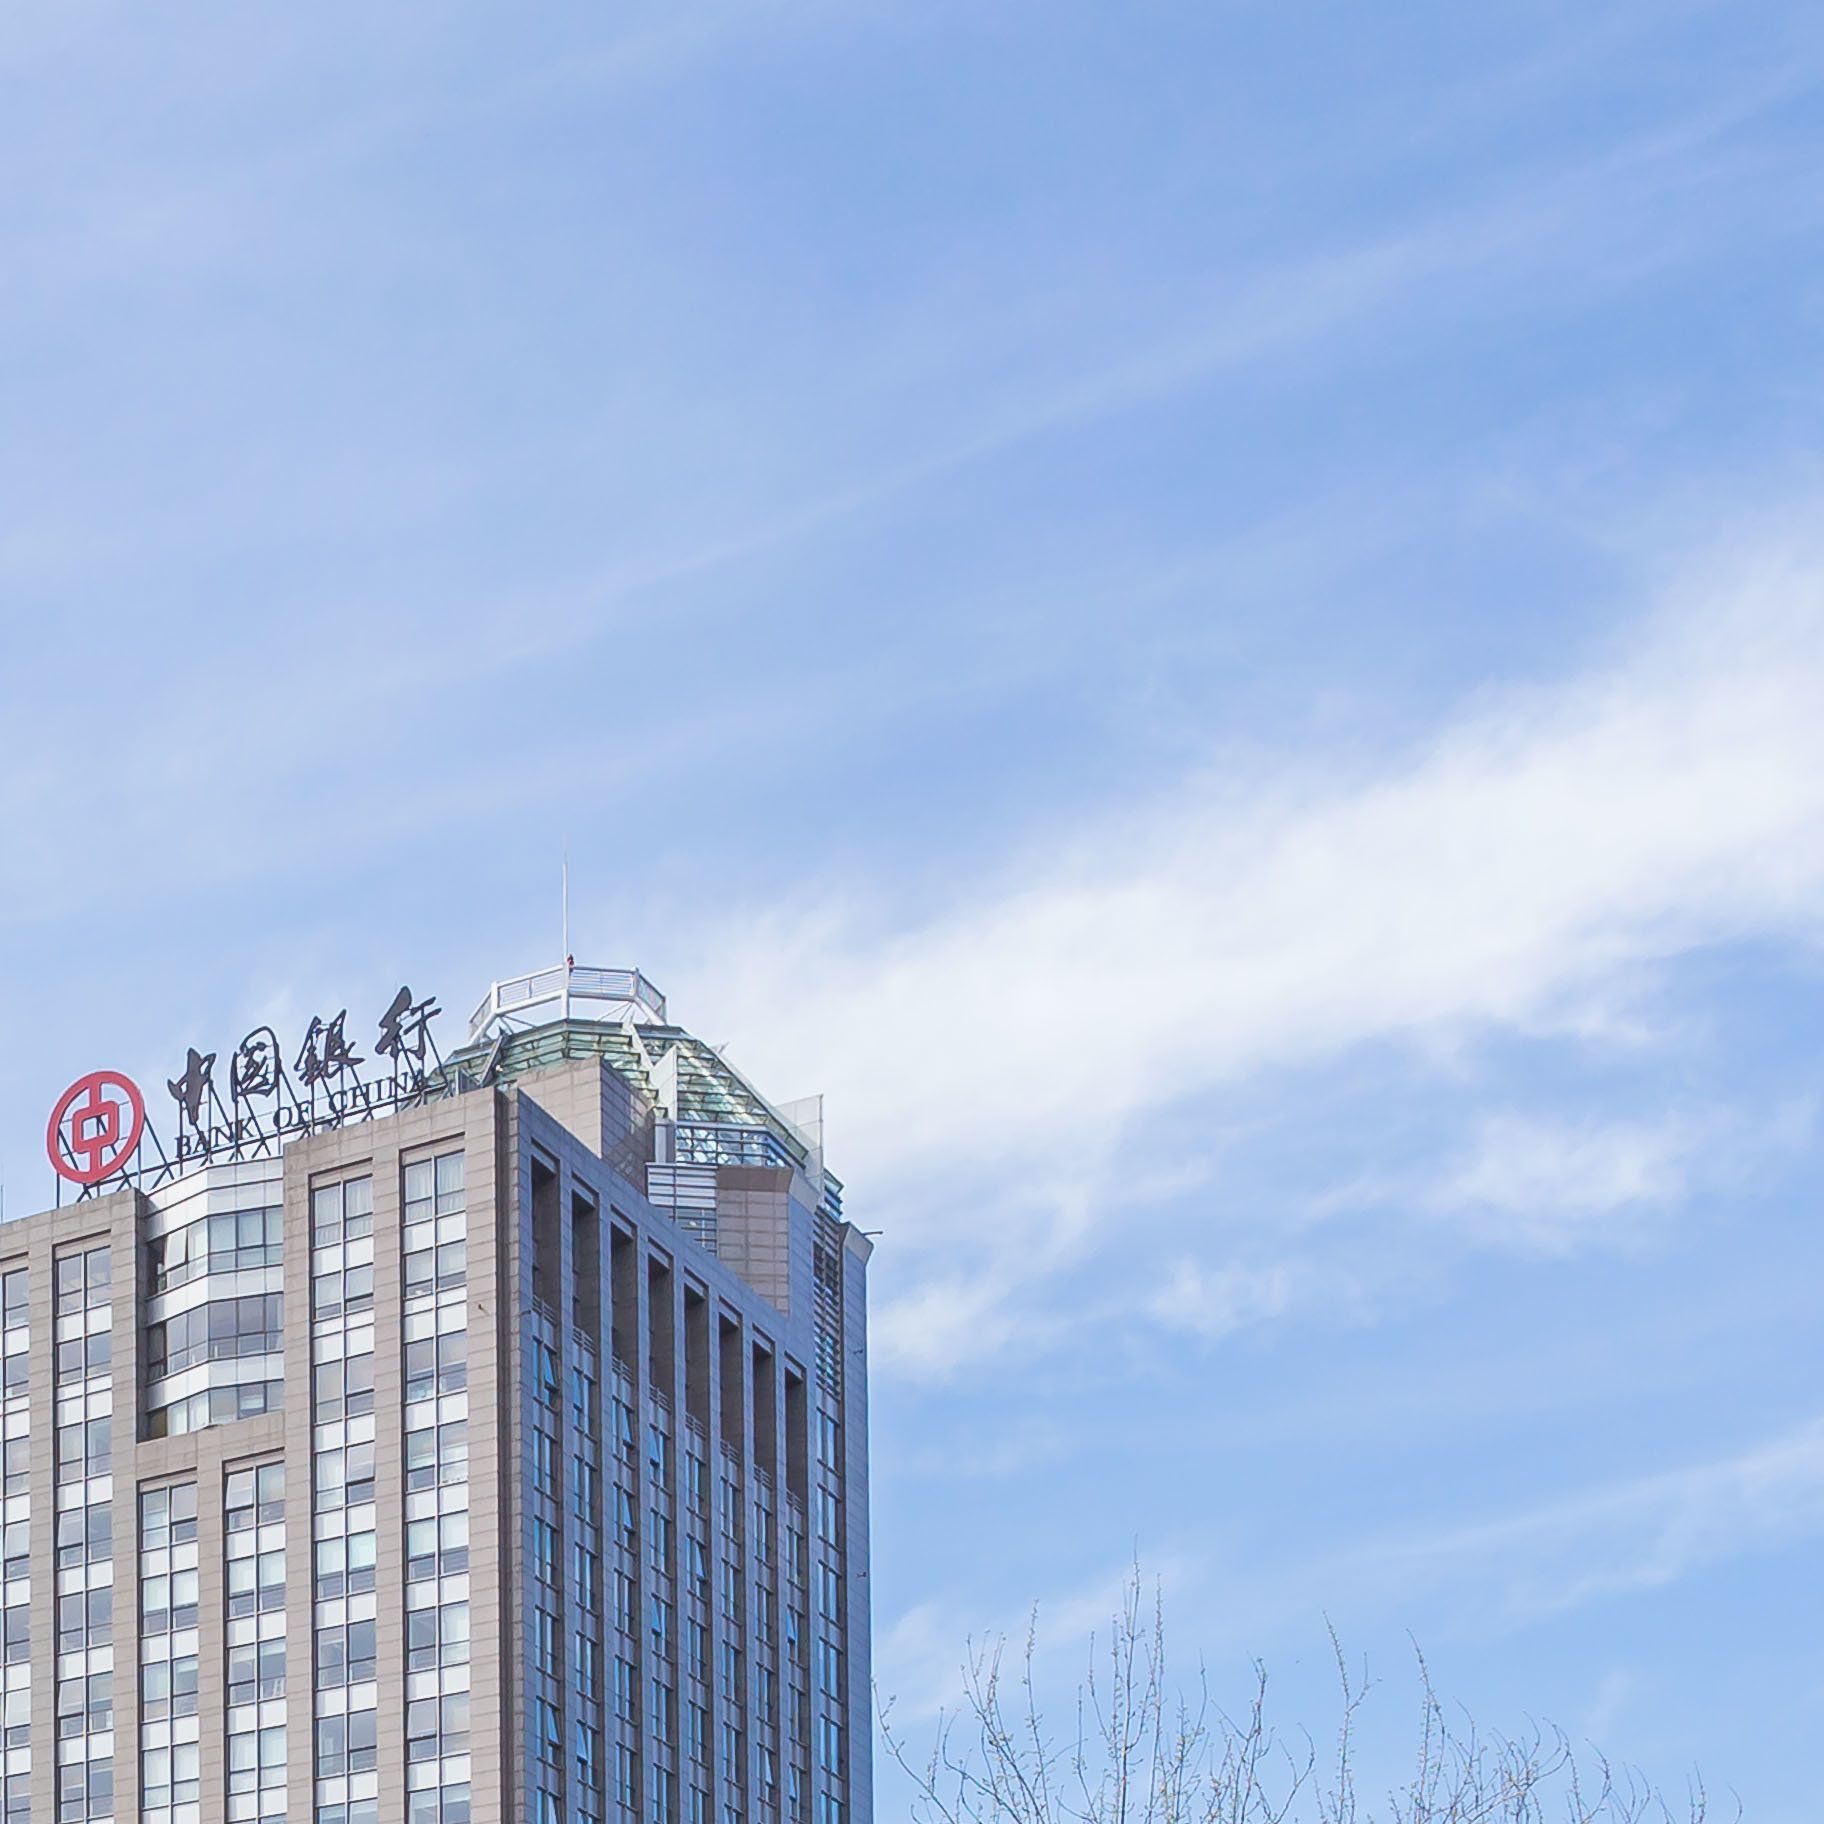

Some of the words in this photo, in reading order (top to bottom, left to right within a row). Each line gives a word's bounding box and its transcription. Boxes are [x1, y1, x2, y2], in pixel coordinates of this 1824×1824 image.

[174, 1116, 255, 1159] BANK
[273, 1101, 312, 1129] OF
[328, 1068, 426, 1113] CHINA
